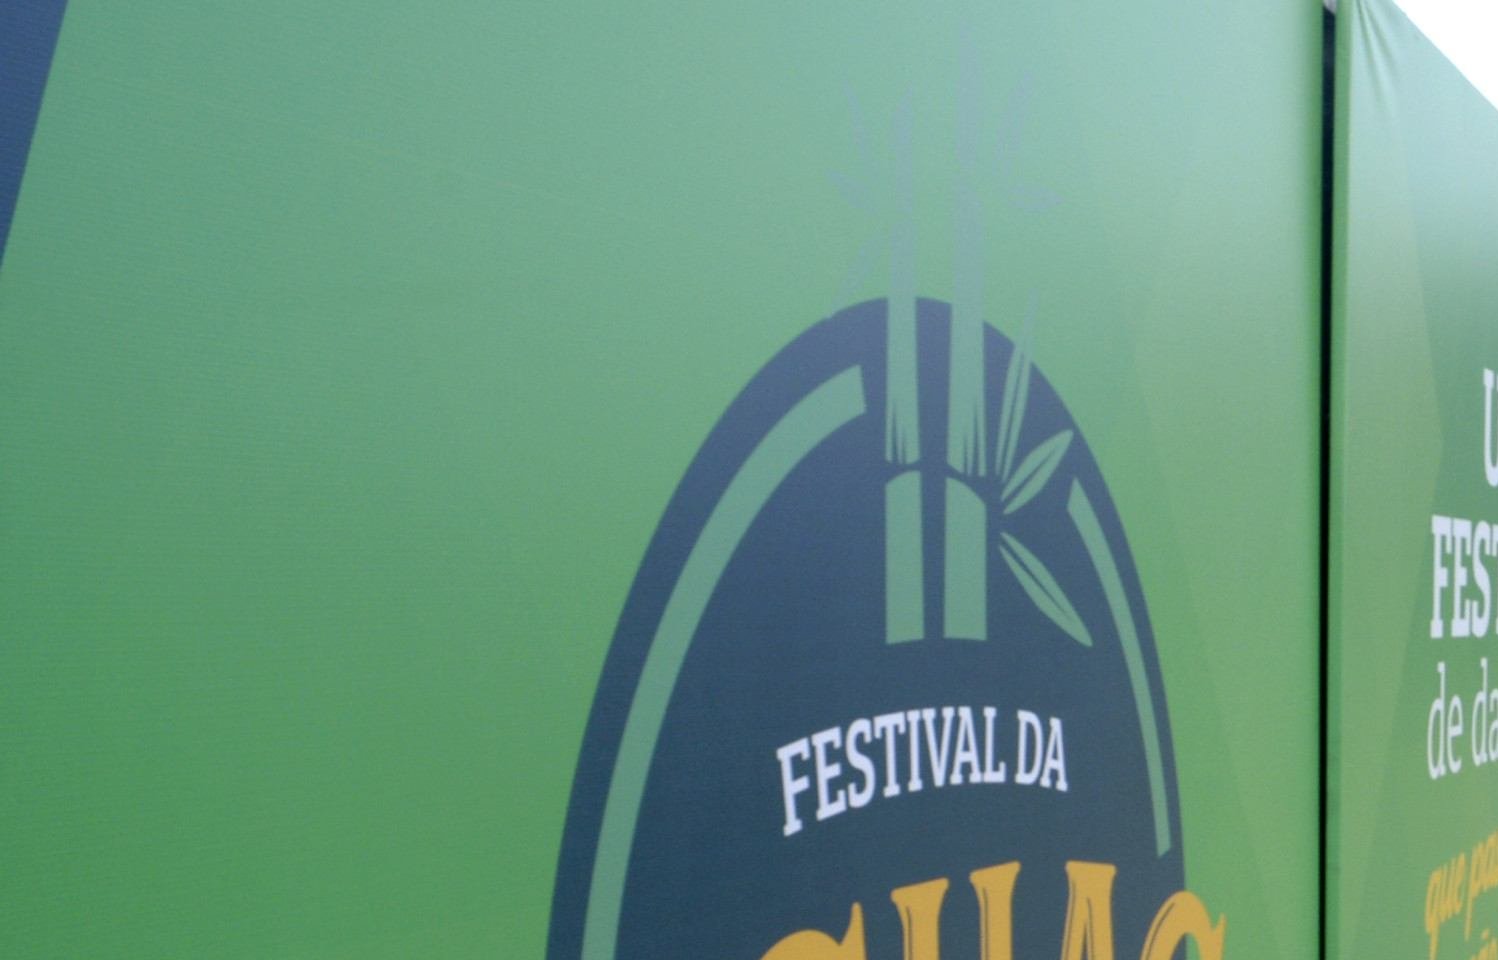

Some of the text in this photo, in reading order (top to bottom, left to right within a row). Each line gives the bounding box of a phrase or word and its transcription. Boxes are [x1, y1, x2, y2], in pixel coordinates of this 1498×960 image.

[776, 706, 1068, 837] FESTIVAL DA
[1427, 661, 1463, 779] de
